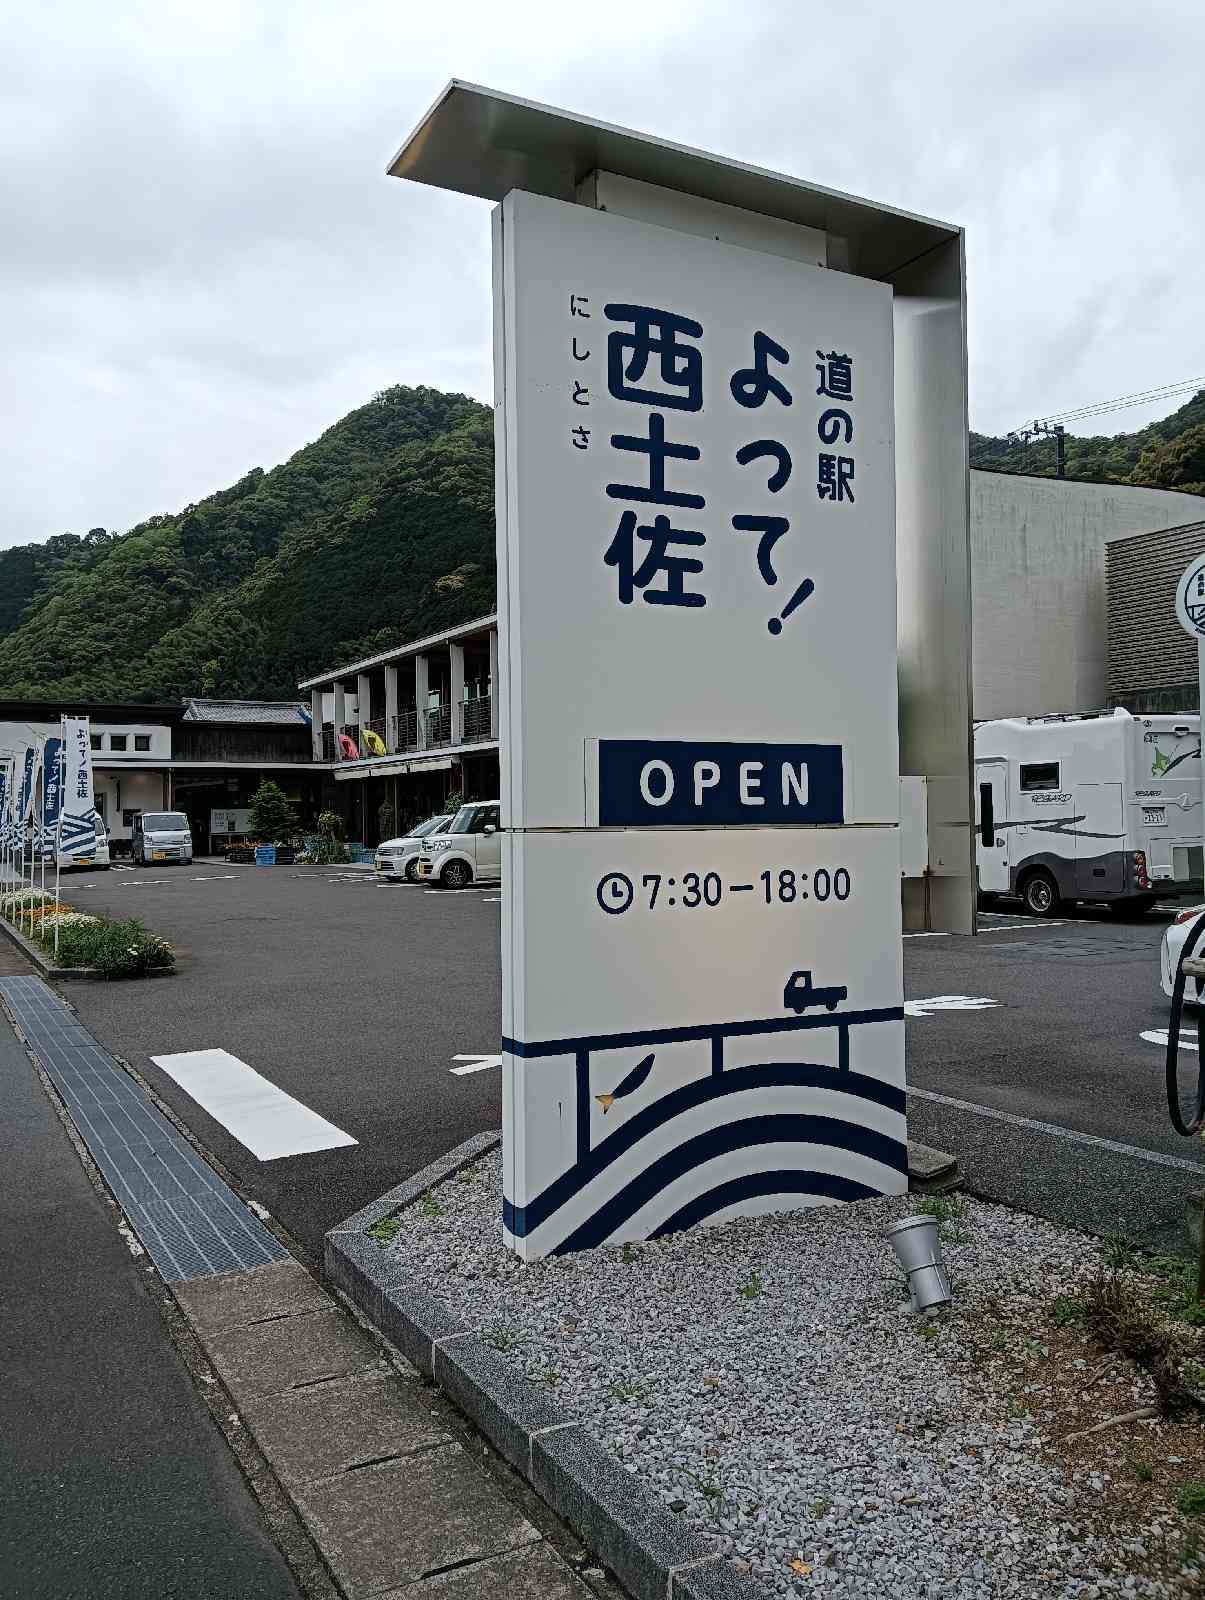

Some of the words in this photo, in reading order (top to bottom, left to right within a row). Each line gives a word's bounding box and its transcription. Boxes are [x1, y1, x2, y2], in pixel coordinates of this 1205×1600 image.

[570, 294, 591, 450] にしとさ
[815, 349, 855, 504] 道の駅
[603, 303, 707, 608] 西土佐
[639, 759, 810, 807] OPEN
